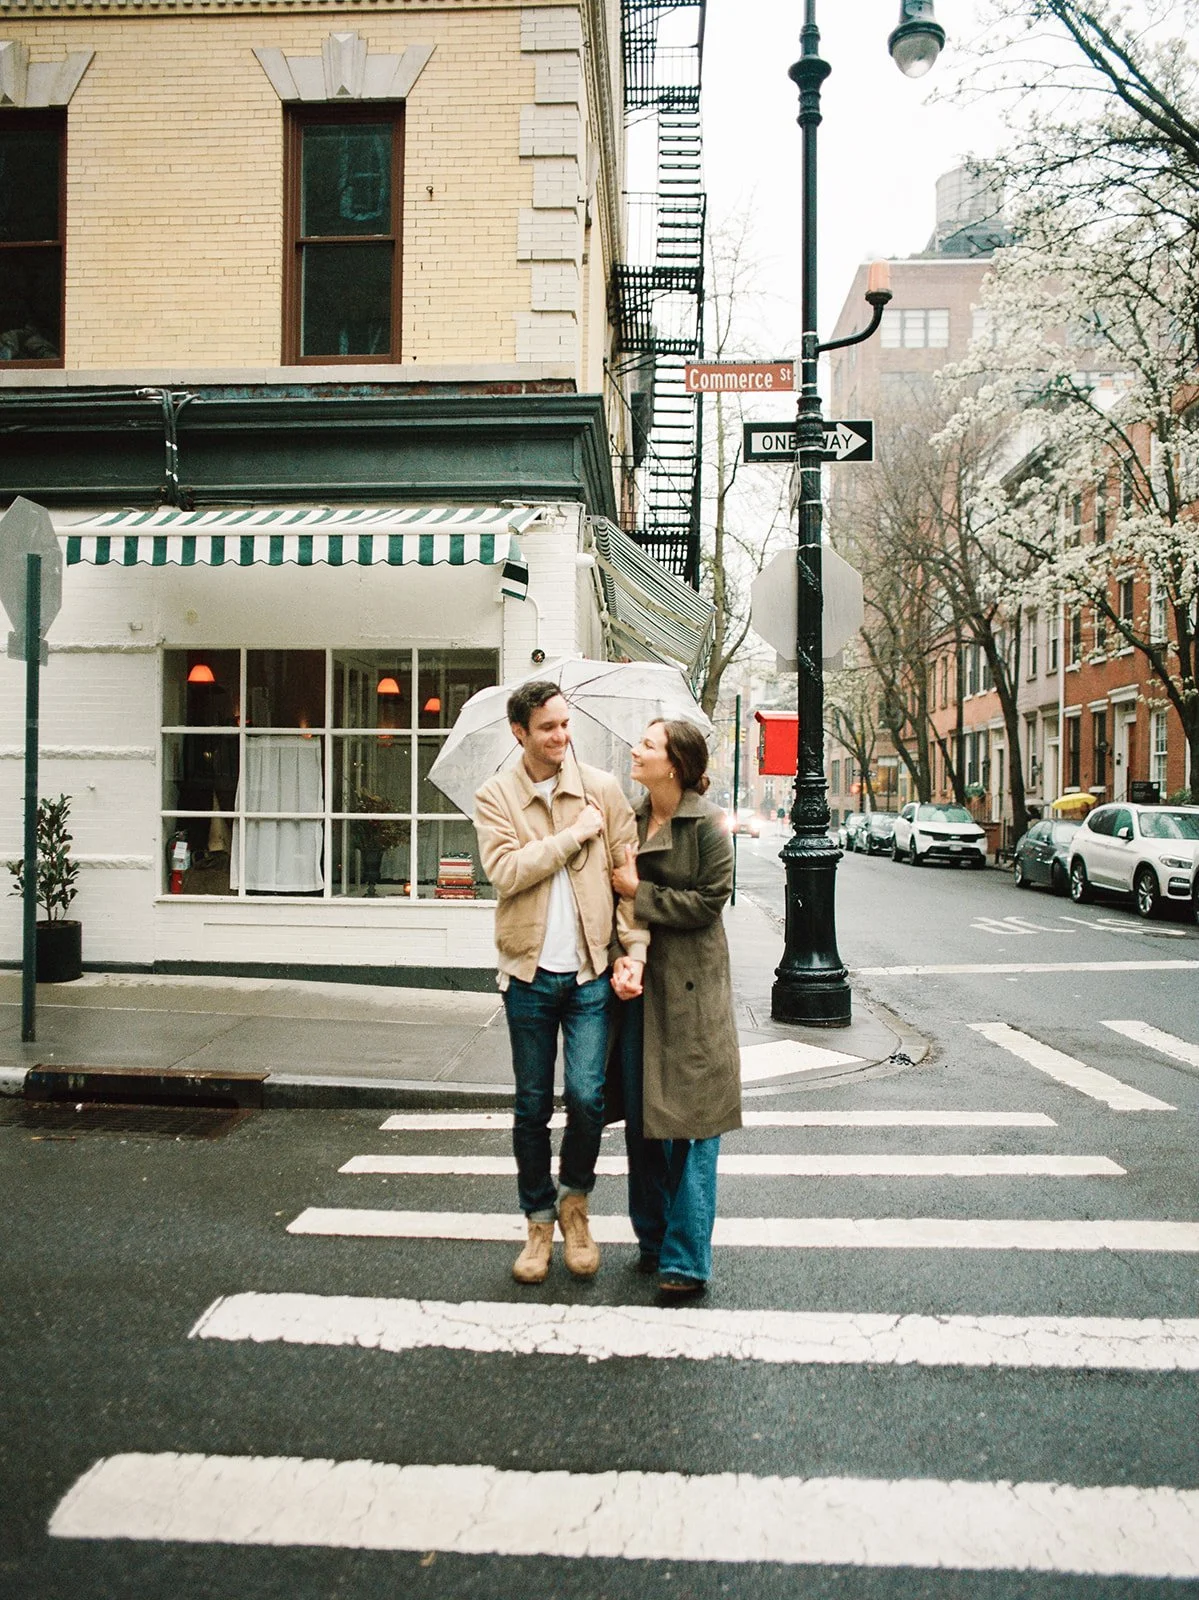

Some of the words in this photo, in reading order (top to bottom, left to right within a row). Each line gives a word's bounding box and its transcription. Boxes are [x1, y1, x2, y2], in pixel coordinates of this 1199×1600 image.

[689, 368, 773, 389] Commerce
[780, 368, 792, 381] St
[762, 435, 797, 450] ONE
